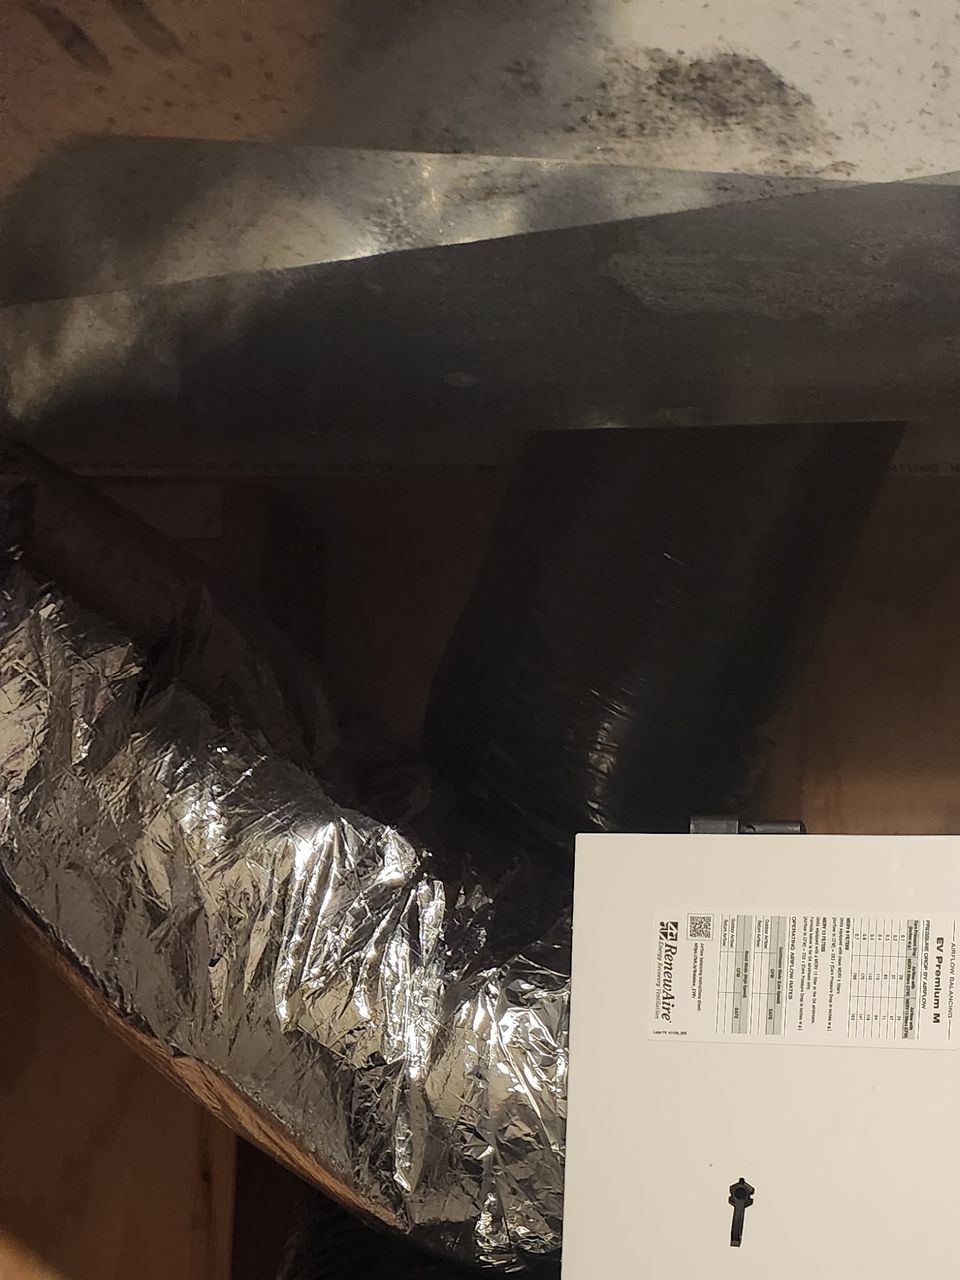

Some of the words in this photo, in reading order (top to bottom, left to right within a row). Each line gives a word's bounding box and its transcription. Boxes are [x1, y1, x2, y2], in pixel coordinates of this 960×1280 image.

[656, 941, 664, 961] Energy
[936, 937, 944, 952] EV
[923, 972, 928, 981] BY
[934, 956, 943, 1009] Premium
[654, 988, 662, 1019] Ventilation
[947, 977, 955, 1018] BALANCING
[933, 1013, 940, 1023] M
